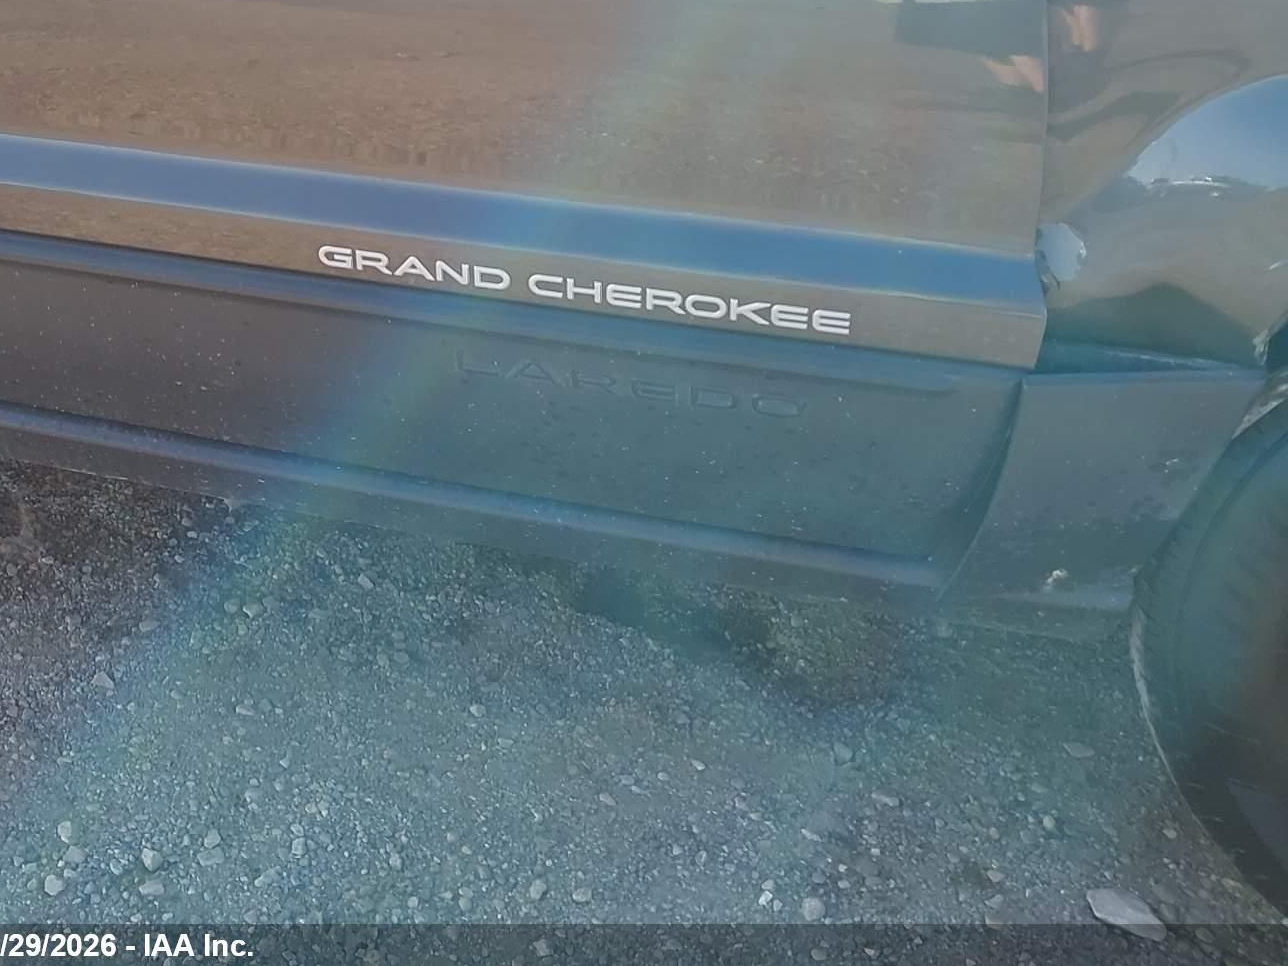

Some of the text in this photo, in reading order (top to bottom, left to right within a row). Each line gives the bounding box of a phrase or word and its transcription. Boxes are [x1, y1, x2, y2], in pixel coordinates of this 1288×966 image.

[318, 244, 852, 335] GRAND CHEROKEE
[455, 350, 808, 419] LAREDO
